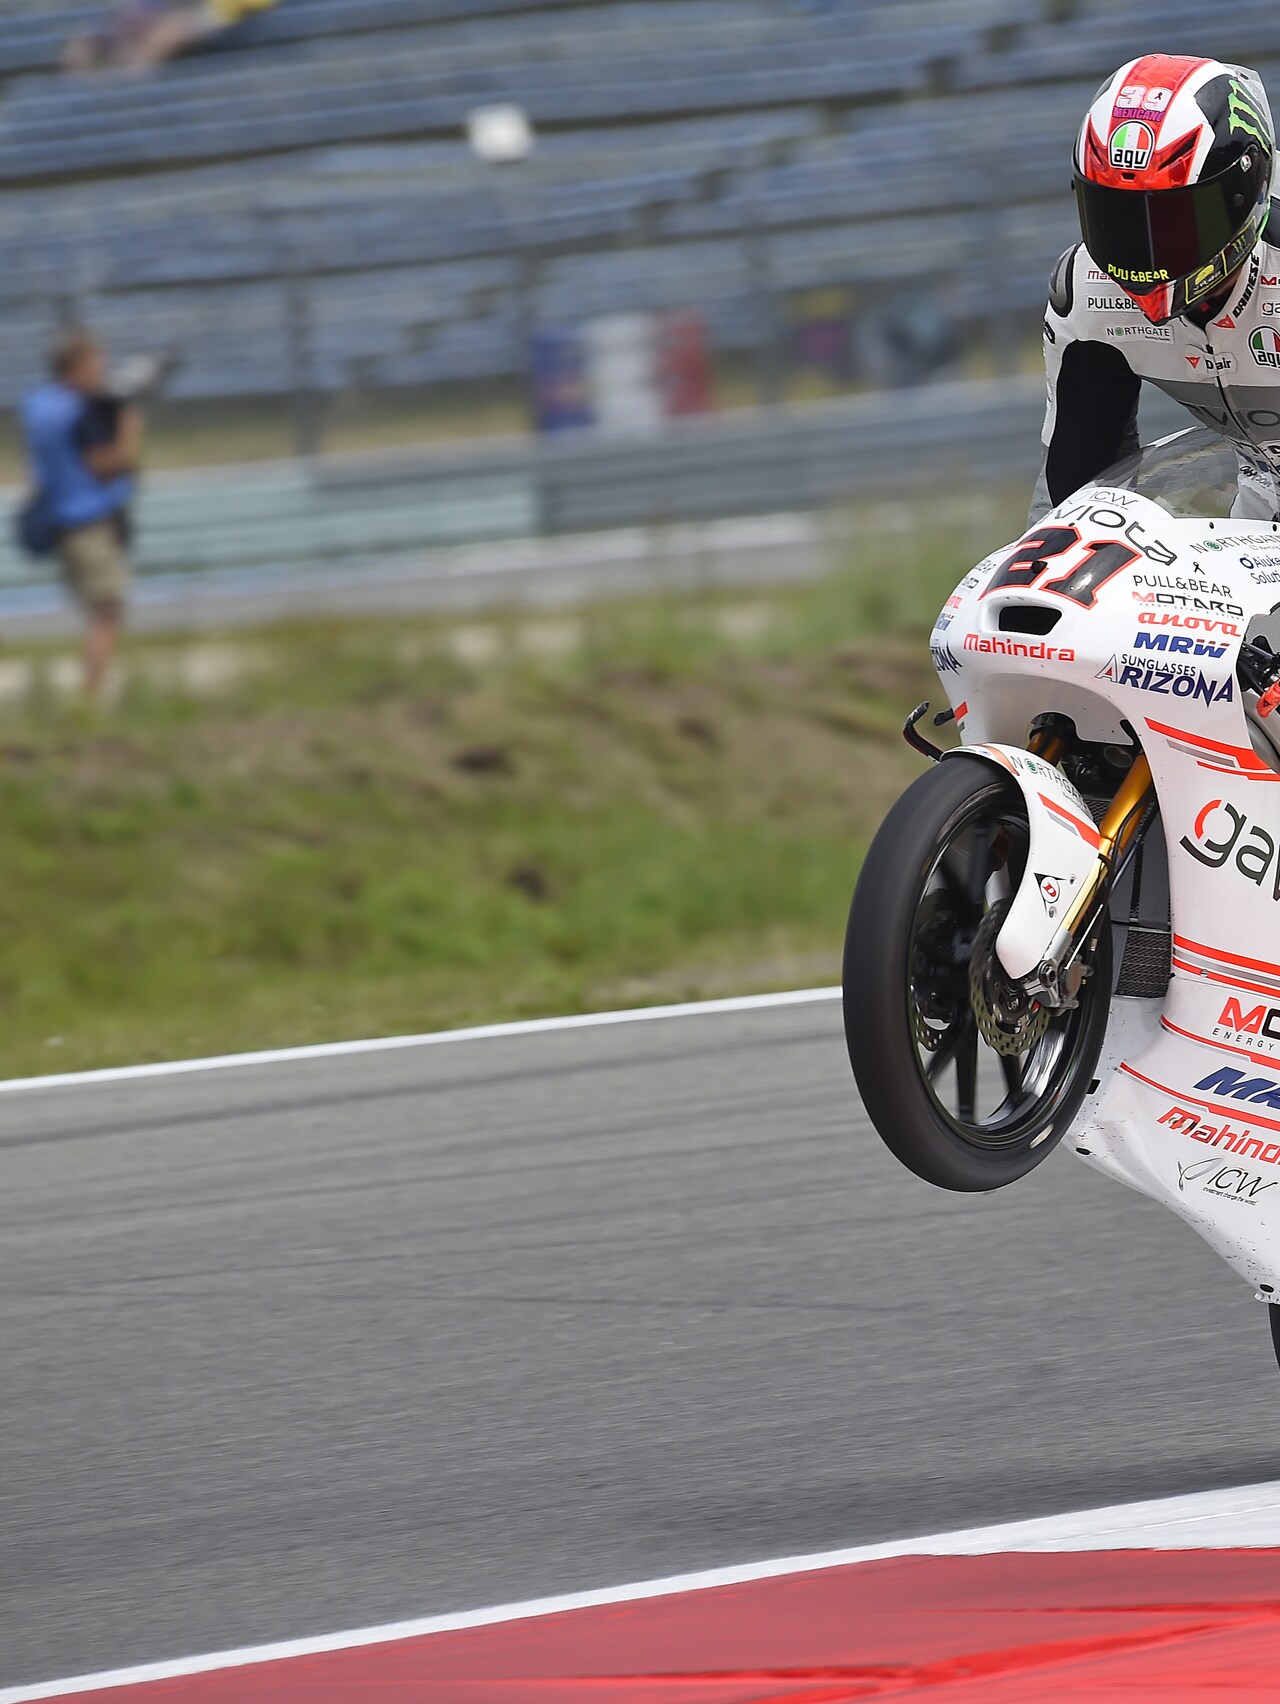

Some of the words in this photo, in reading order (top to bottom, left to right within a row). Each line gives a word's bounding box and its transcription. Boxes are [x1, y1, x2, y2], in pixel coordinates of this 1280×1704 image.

[1116, 86, 1173, 111] 39
[1113, 149, 1147, 168] agv
[1107, 263, 1170, 283] PULL&BEAR
[1232, 251, 1260, 319] DAINESE
[1087, 297, 1138, 310] PULL&BE
[1089, 491, 1138, 506] ICW
[1133, 575, 1233, 599] PULL&BEAR
[1132, 591, 1244, 617] MOTARD
[1138, 612, 1241, 637] anova
[964, 633, 1075, 662] Mahindra
[1133, 632, 1231, 659] MRW
[1121, 654, 1197, 677] SUNGLASSES
[1094, 653, 1234, 708] ARIZONA
[1212, 1027, 1275, 1051] ENERGY
[1206, 1166, 1279, 1198] ICW
